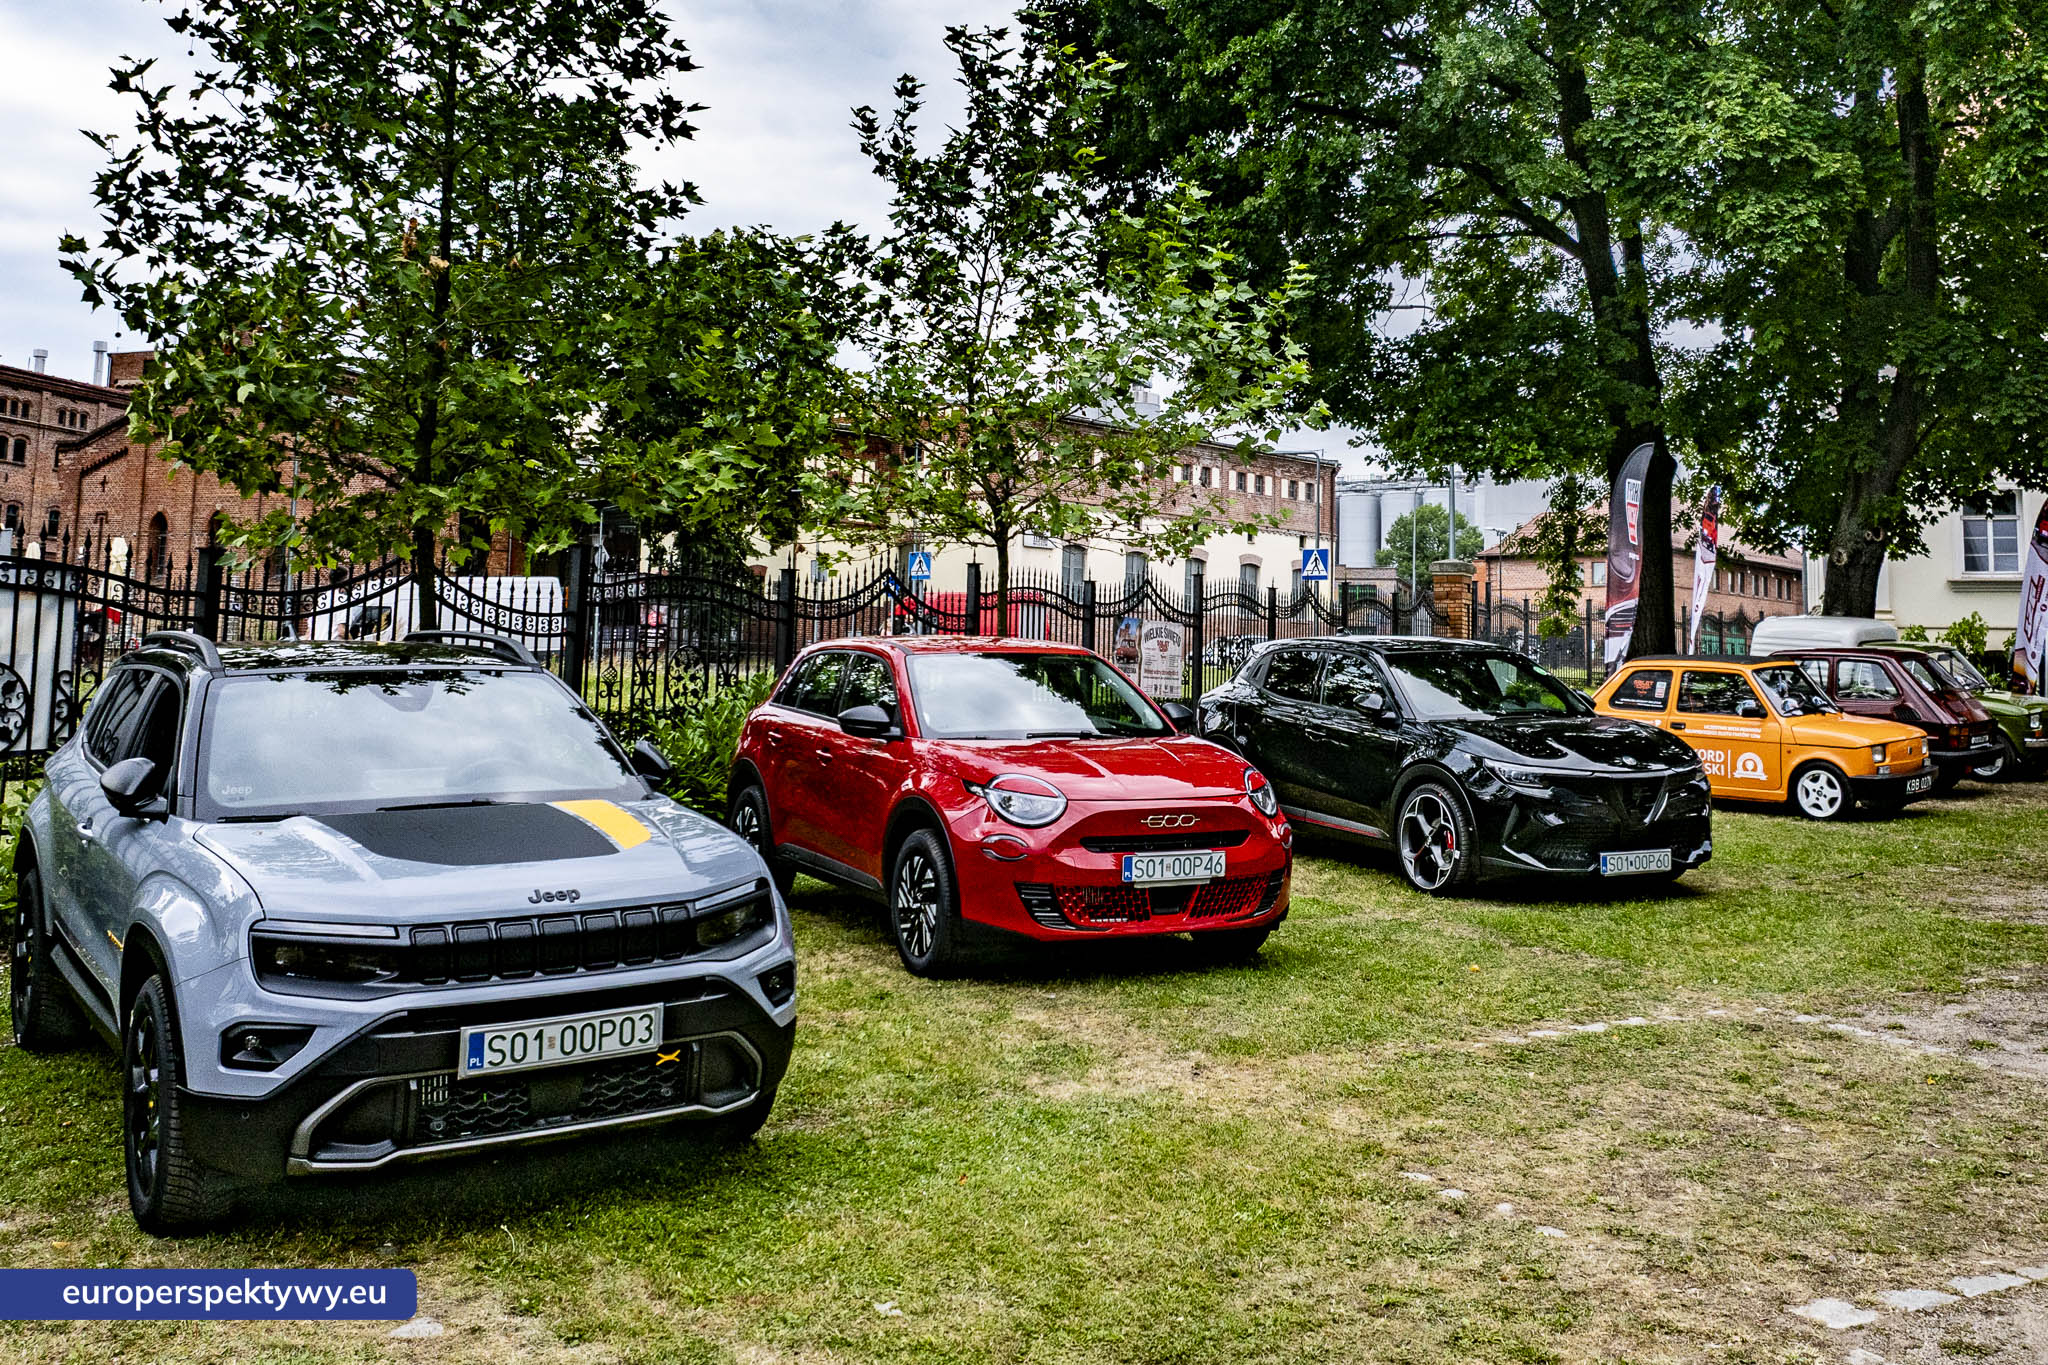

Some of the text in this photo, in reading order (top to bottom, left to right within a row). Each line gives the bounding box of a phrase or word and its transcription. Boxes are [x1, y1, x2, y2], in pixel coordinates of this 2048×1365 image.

[1144, 627, 1163, 643] WIELKIE
[1704, 762, 1725, 776] SKI
[221, 784, 253, 796] Jeep
[1906, 779, 1920, 791] KBB
[1145, 814, 1197, 828] 600
[528, 889, 581, 904] Jeep
[469, 1057, 482, 1067] PL
